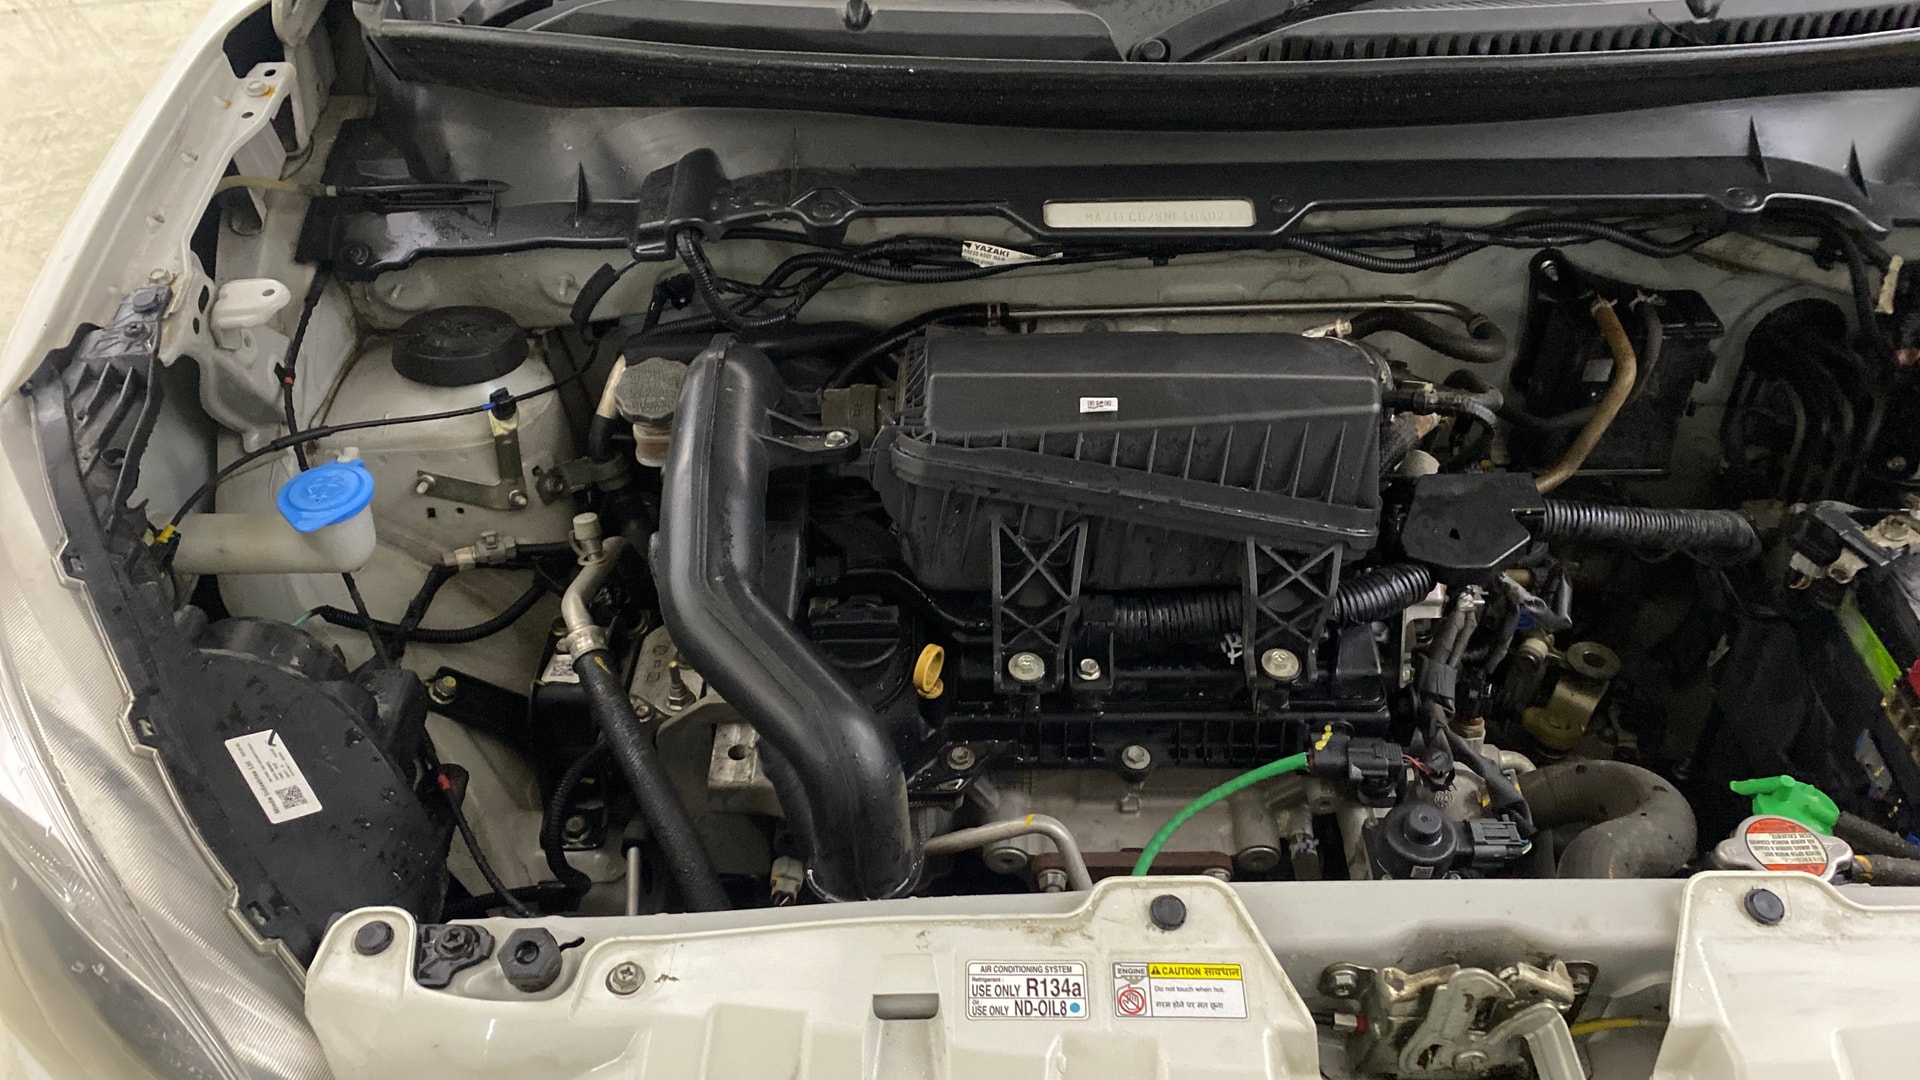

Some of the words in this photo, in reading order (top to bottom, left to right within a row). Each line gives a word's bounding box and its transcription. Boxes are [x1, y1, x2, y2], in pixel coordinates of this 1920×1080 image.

[974, 244, 1010, 257] YAZAKI
[980, 965, 992, 973] AIR
[994, 965, 1043, 973] CONDITIONING
[1162, 966, 1202, 976] CAUTION
[972, 984, 992, 997] USE
[994, 984, 1021, 997] ONLY
[1026, 977, 1081, 997] R134a
[972, 1005, 987, 1016] USE
[989, 1005, 1009, 1016] ONLY
[1014, 1000, 1067, 1016] ND-OIL8
